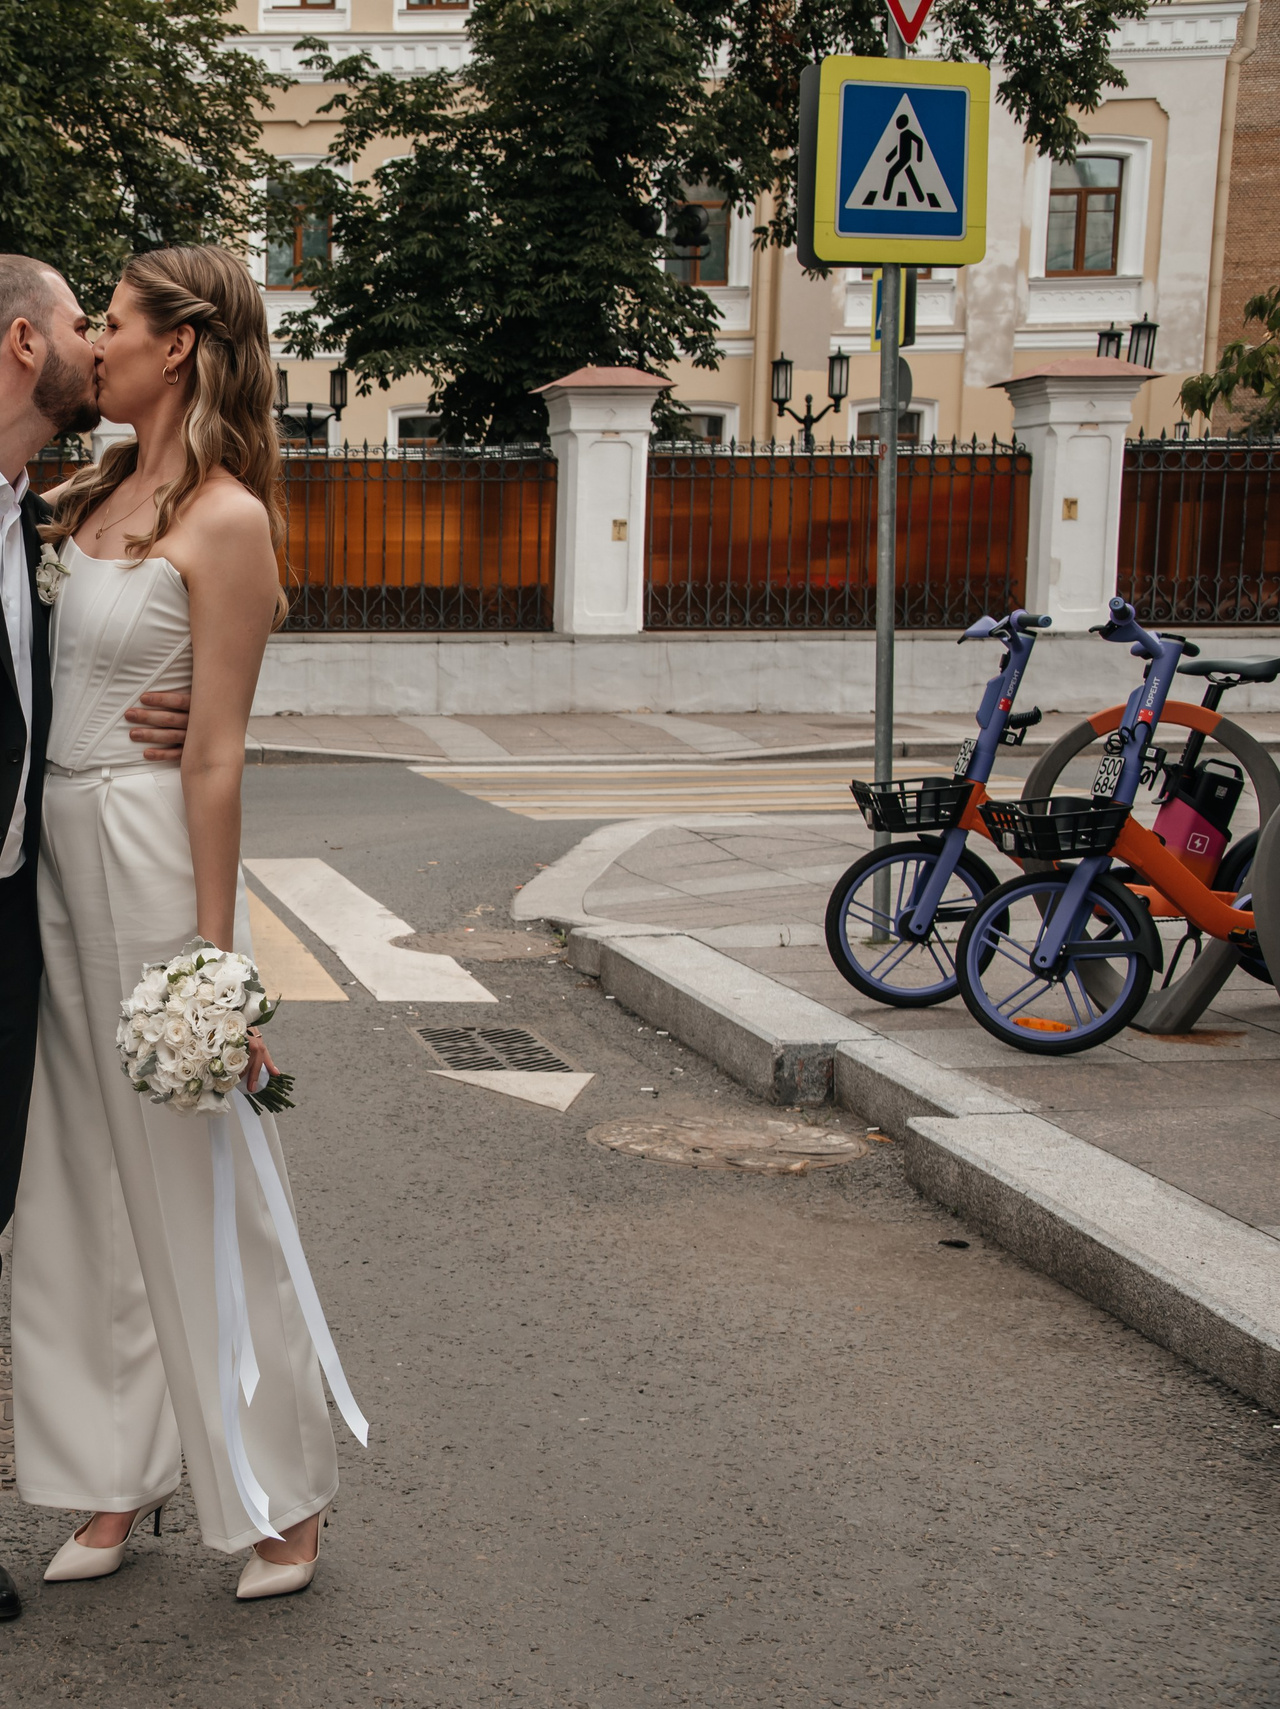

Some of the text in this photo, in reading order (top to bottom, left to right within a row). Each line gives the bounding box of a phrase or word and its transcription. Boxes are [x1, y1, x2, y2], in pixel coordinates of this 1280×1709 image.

[1006, 669, 1020, 697] ЮРЕНТ
[1145, 676, 1161, 707] ЮРЕНТ
[1099, 757, 1123, 776] 500
[1093, 776, 1116, 795] 684
